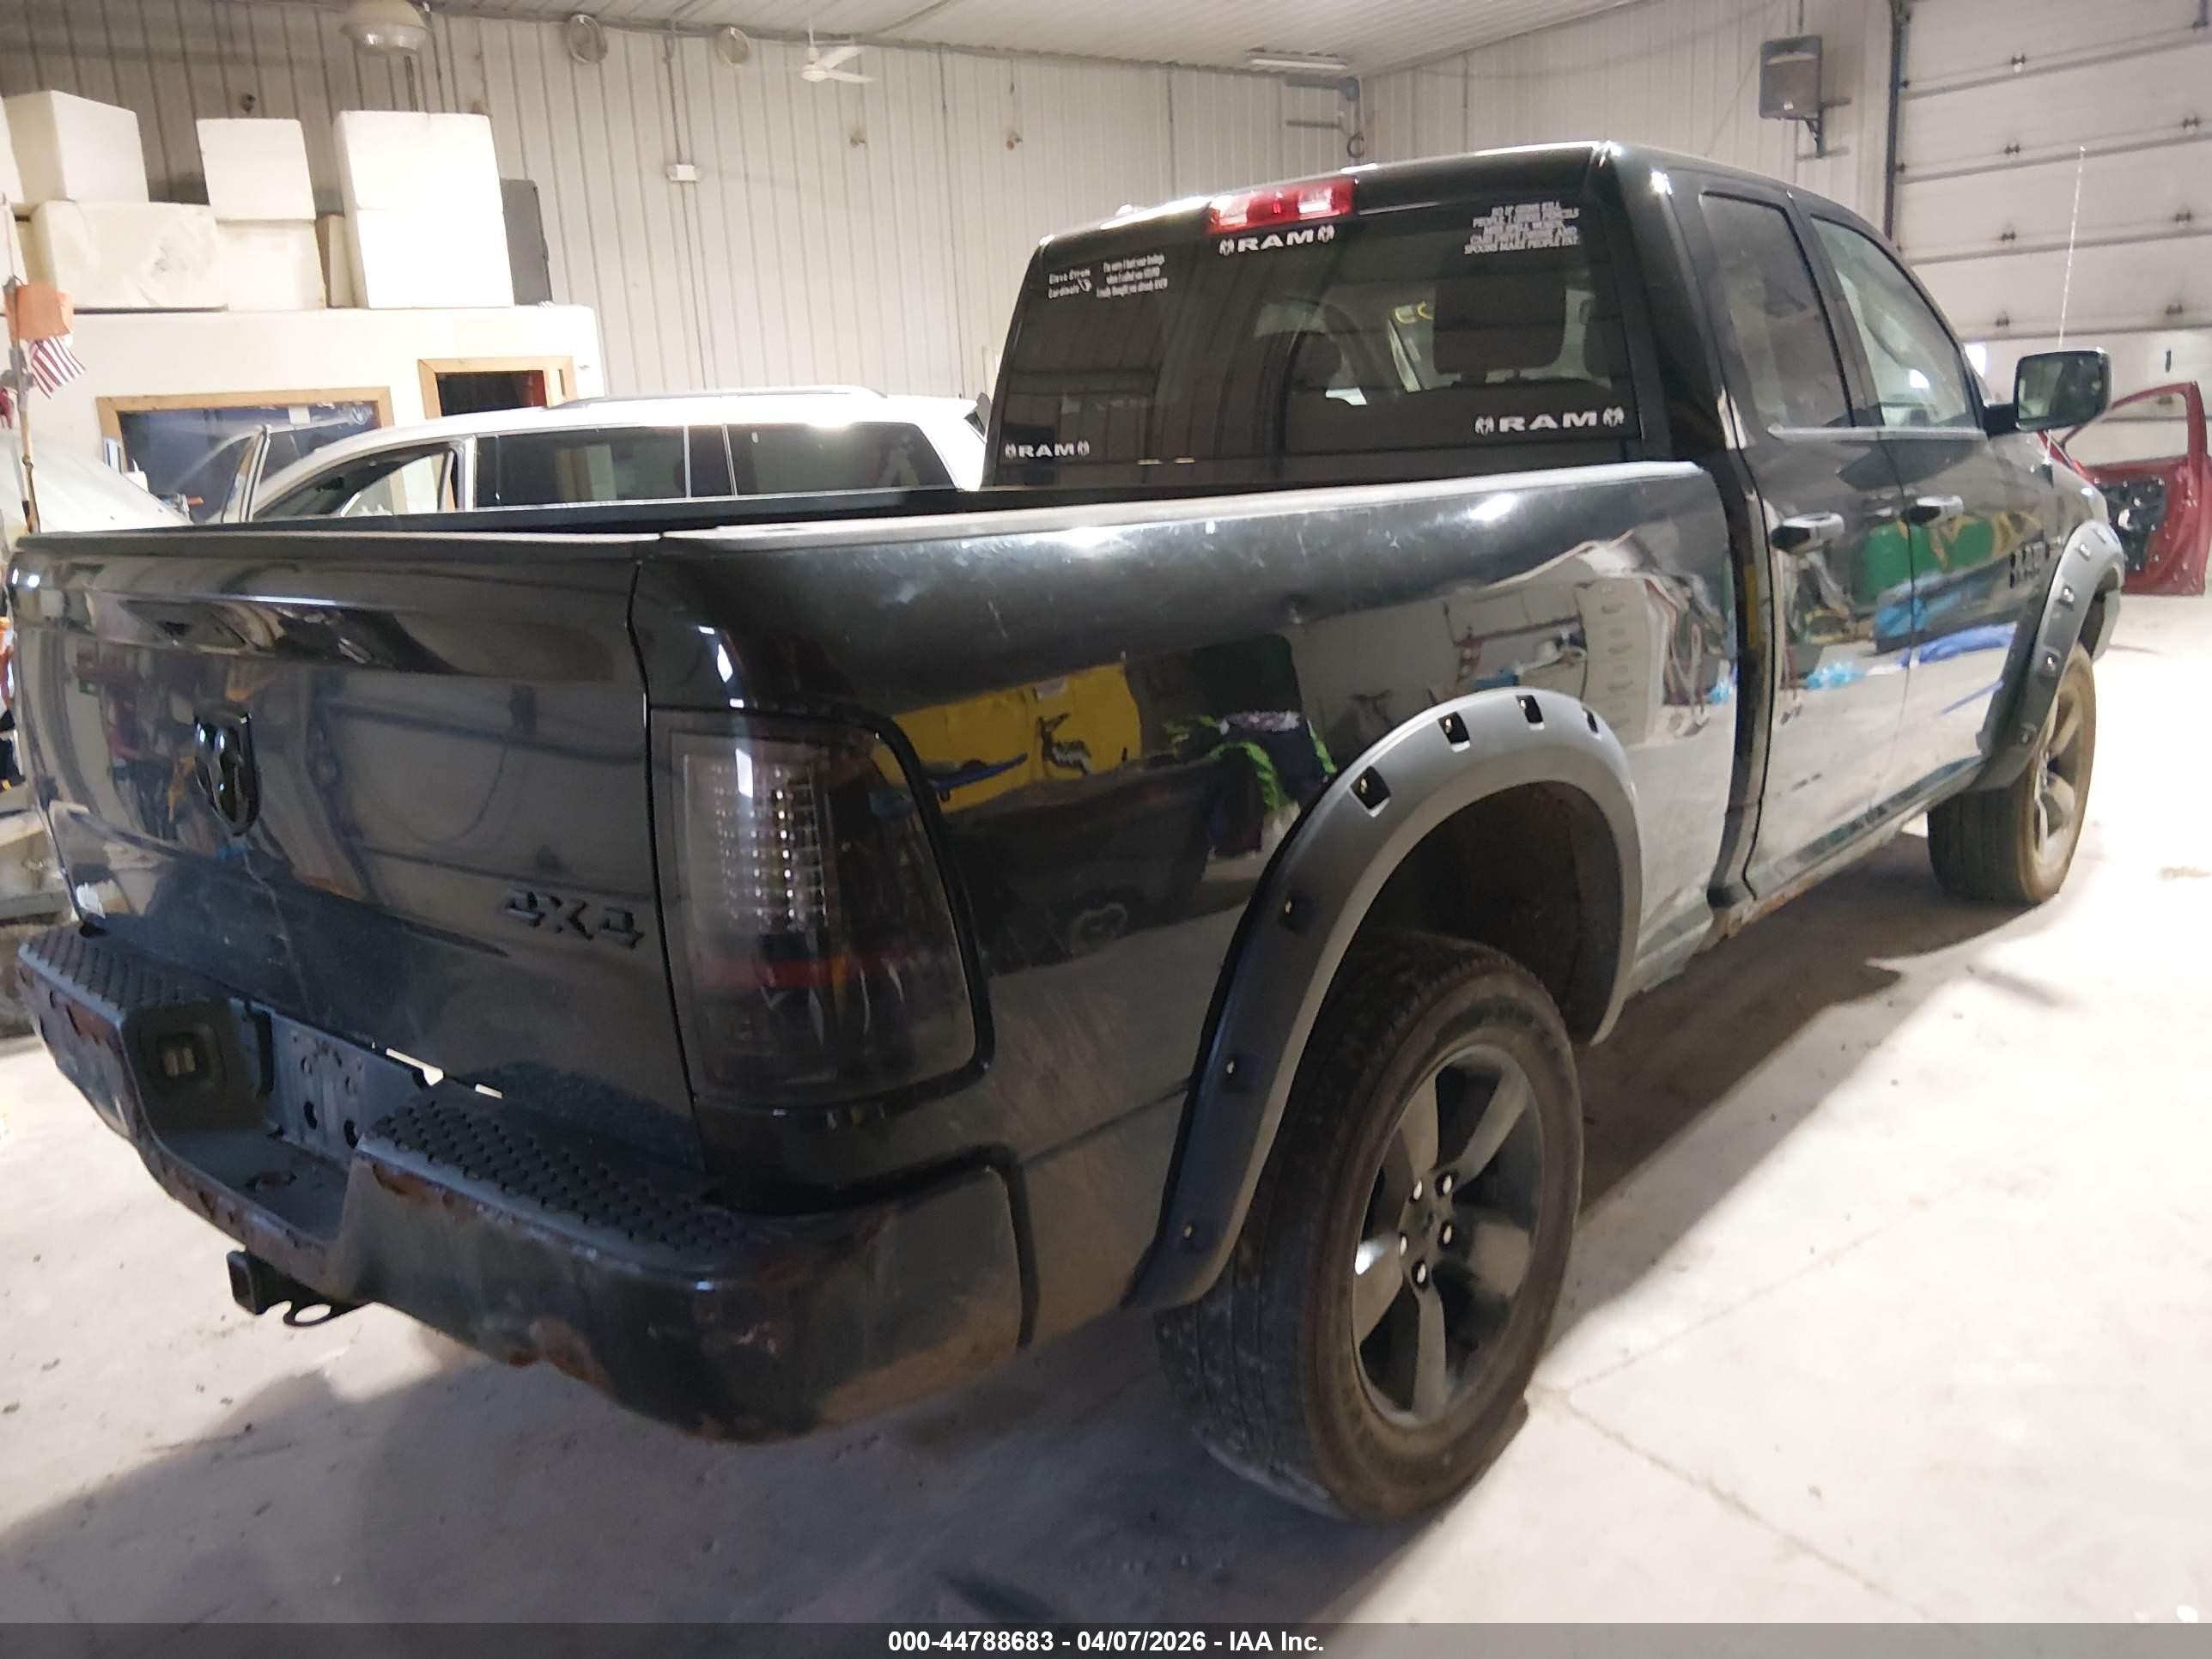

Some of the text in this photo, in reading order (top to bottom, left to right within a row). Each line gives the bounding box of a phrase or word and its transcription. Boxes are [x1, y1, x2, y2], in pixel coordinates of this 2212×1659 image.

[1237, 228, 1314, 252] RAM
[1499, 410, 1598, 433] RAM
[1018, 442, 1074, 458] RAM
